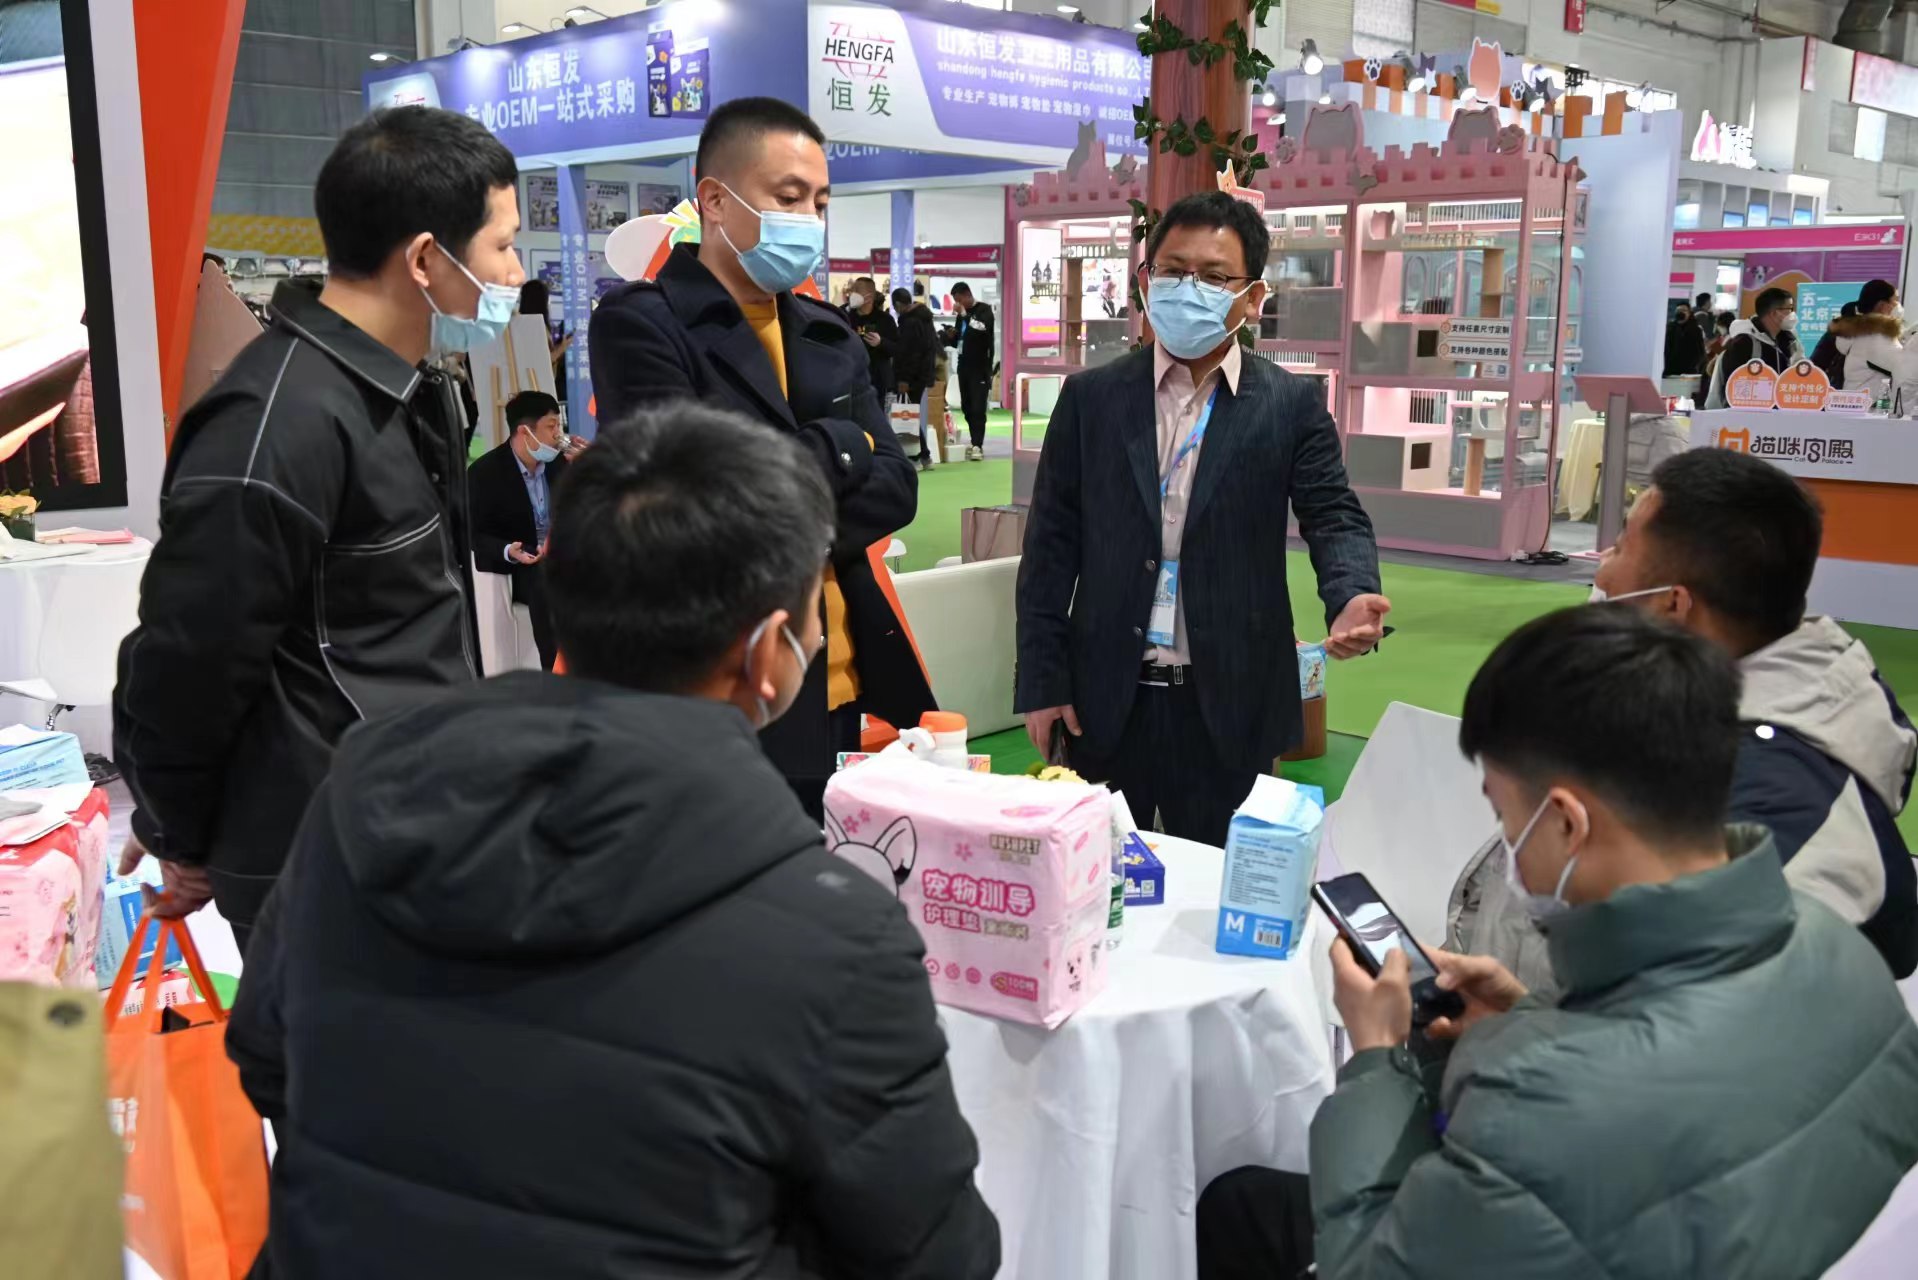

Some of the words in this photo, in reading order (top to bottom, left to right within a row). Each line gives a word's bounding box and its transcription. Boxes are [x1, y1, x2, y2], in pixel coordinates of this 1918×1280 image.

[825, 37, 894, 64] HENGFA
[508, 50, 580, 94] 山东恒发
[827, 77, 892, 117] 恒发
[923, 869, 1036, 917] 宠物训导
[1225, 911, 1245, 934] M
